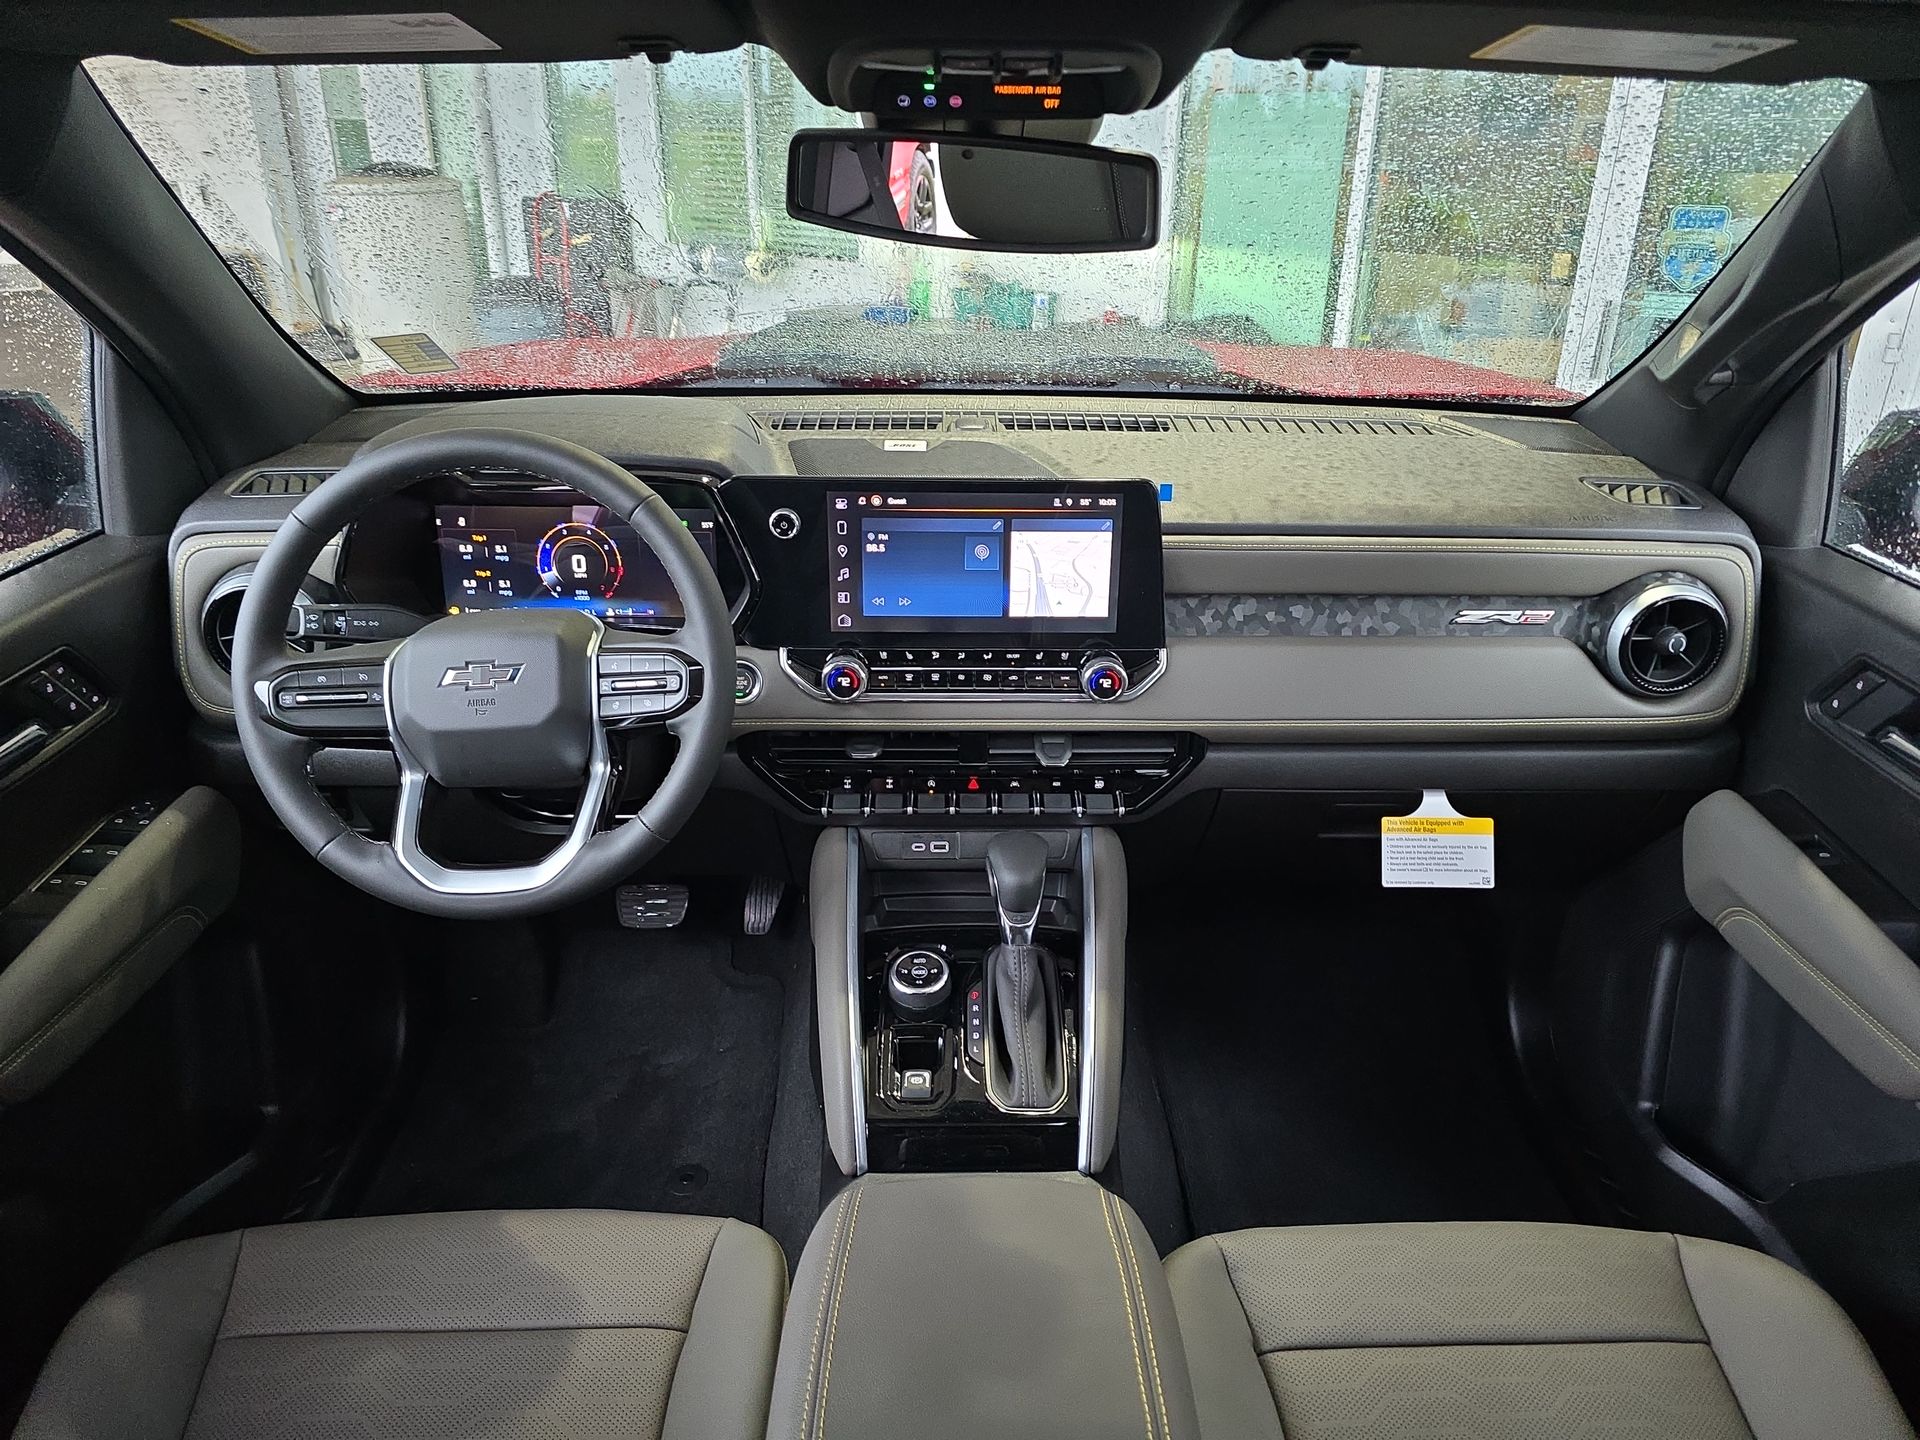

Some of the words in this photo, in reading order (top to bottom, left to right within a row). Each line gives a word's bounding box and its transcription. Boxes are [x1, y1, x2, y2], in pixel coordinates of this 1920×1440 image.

[994, 86, 1033, 94] PASSENGER
[1034, 86, 1046, 94] AIR
[1044, 98, 1060, 108] OFF
[572, 554, 586, 573] 0
[1451, 610, 1555, 624] ZR2
[838, 677, 850, 686] 72
[1100, 678, 1112, 688] 72
[467, 698, 496, 707] AIRBAG
